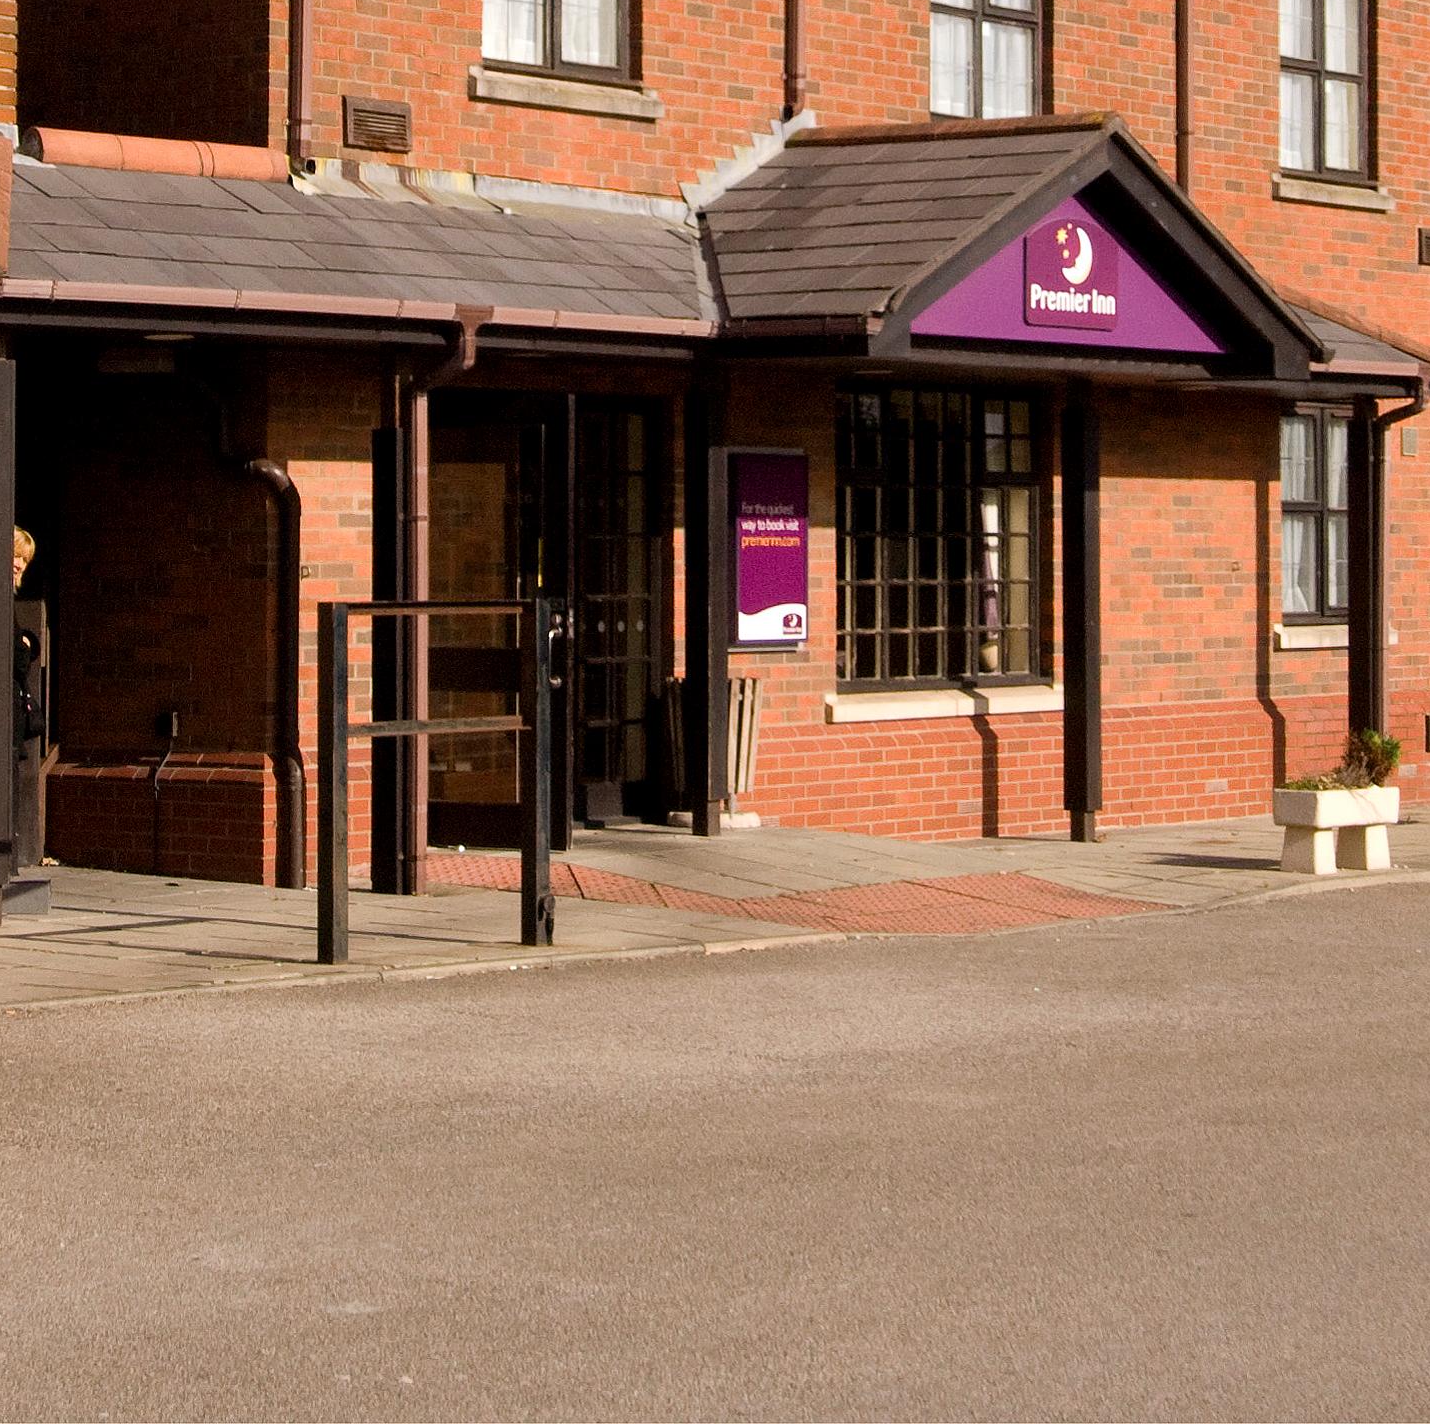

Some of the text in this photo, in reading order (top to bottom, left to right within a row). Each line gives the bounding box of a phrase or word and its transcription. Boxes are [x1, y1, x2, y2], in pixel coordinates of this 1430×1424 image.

[1030, 283, 1116, 315] Premier Inn
[741, 520, 756, 534] way
[757, 519, 765, 531] to
[766, 518, 784, 531] book
